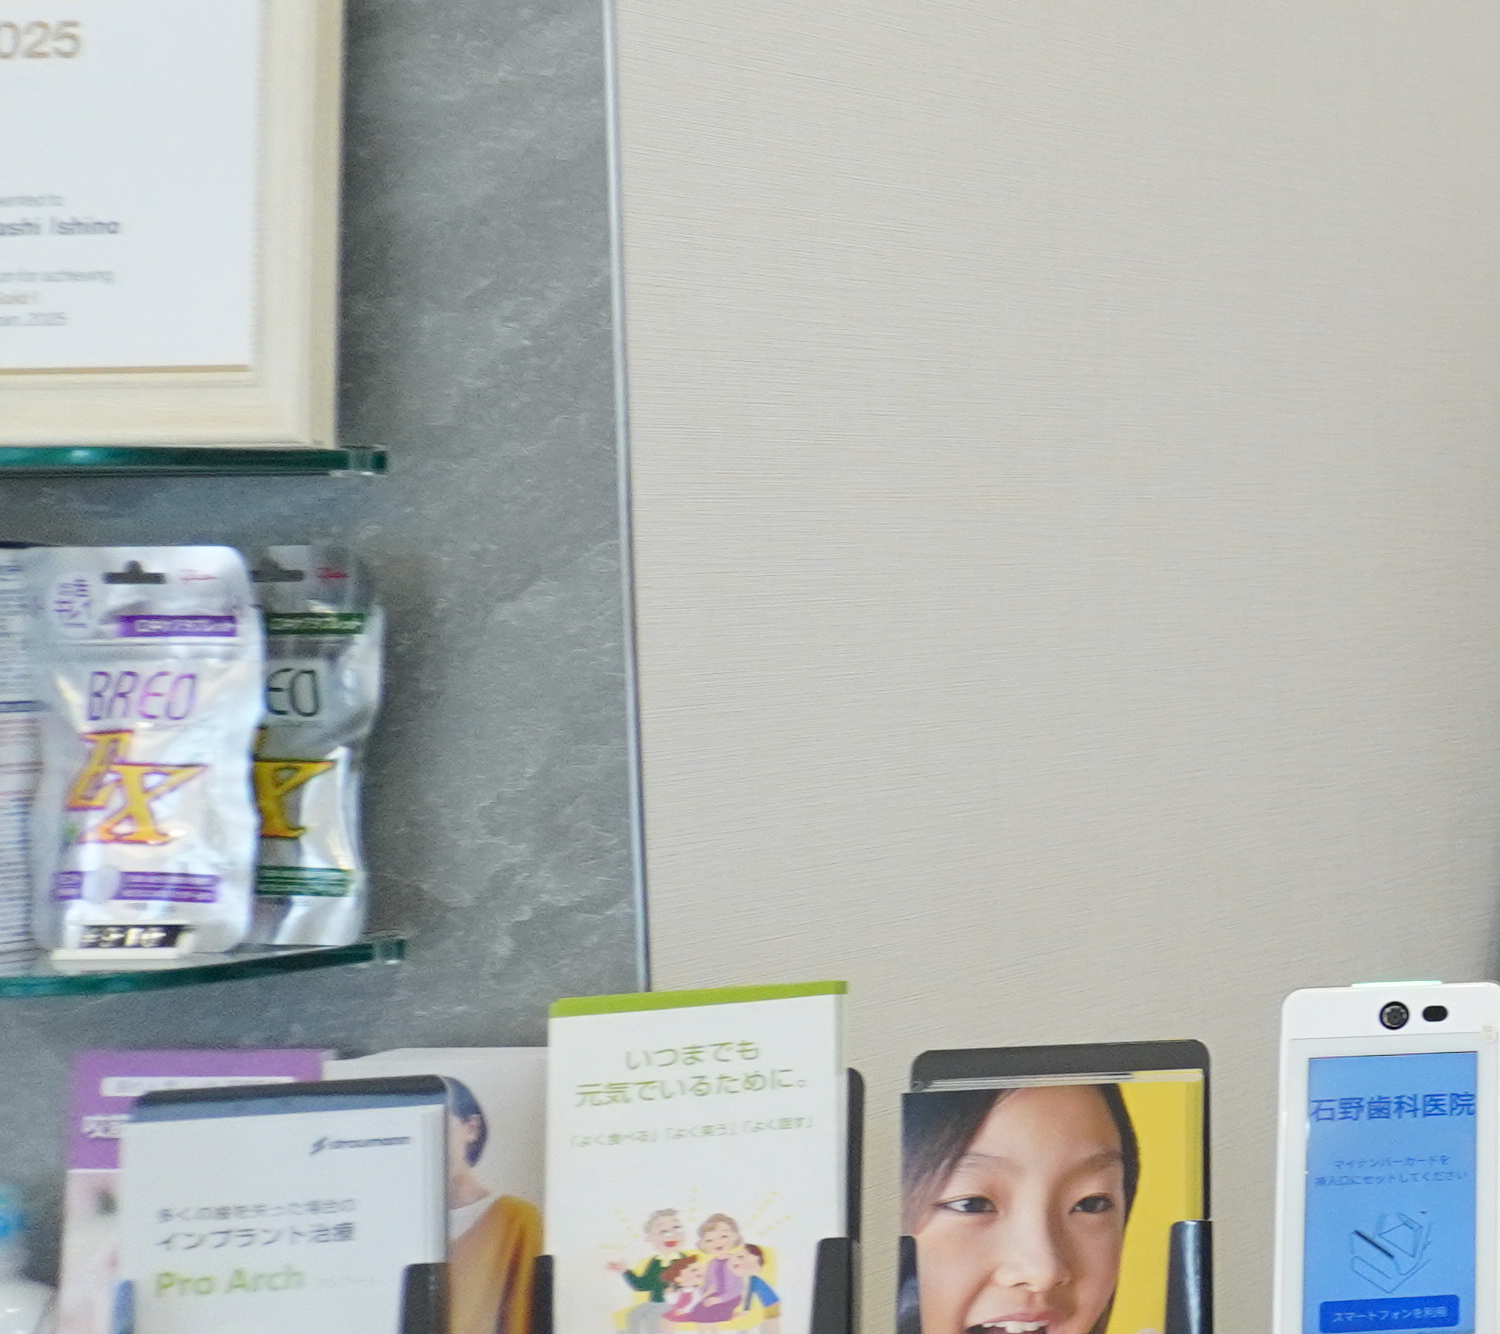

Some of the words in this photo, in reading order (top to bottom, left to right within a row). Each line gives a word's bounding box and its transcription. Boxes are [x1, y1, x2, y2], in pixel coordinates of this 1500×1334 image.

[87, 670, 198, 721] BREO
[625, 1040, 760, 1070] いつまでも
[575, 1068, 808, 1107] 元気でいるために。
[1310, 1091, 1476, 1122] 石野歯科医院
[1334, 1154, 1451, 1170] マイナンバーカードを
[1315, 1170, 1468, 1187] 挿入口にセットしてください
[155, 1221, 355, 1252] インプラント治療
[156, 1271, 214, 1297] Pro
[226, 1264, 304, 1294] Arch
[1332, 1305, 1449, 1324] スマートフォンを利用
